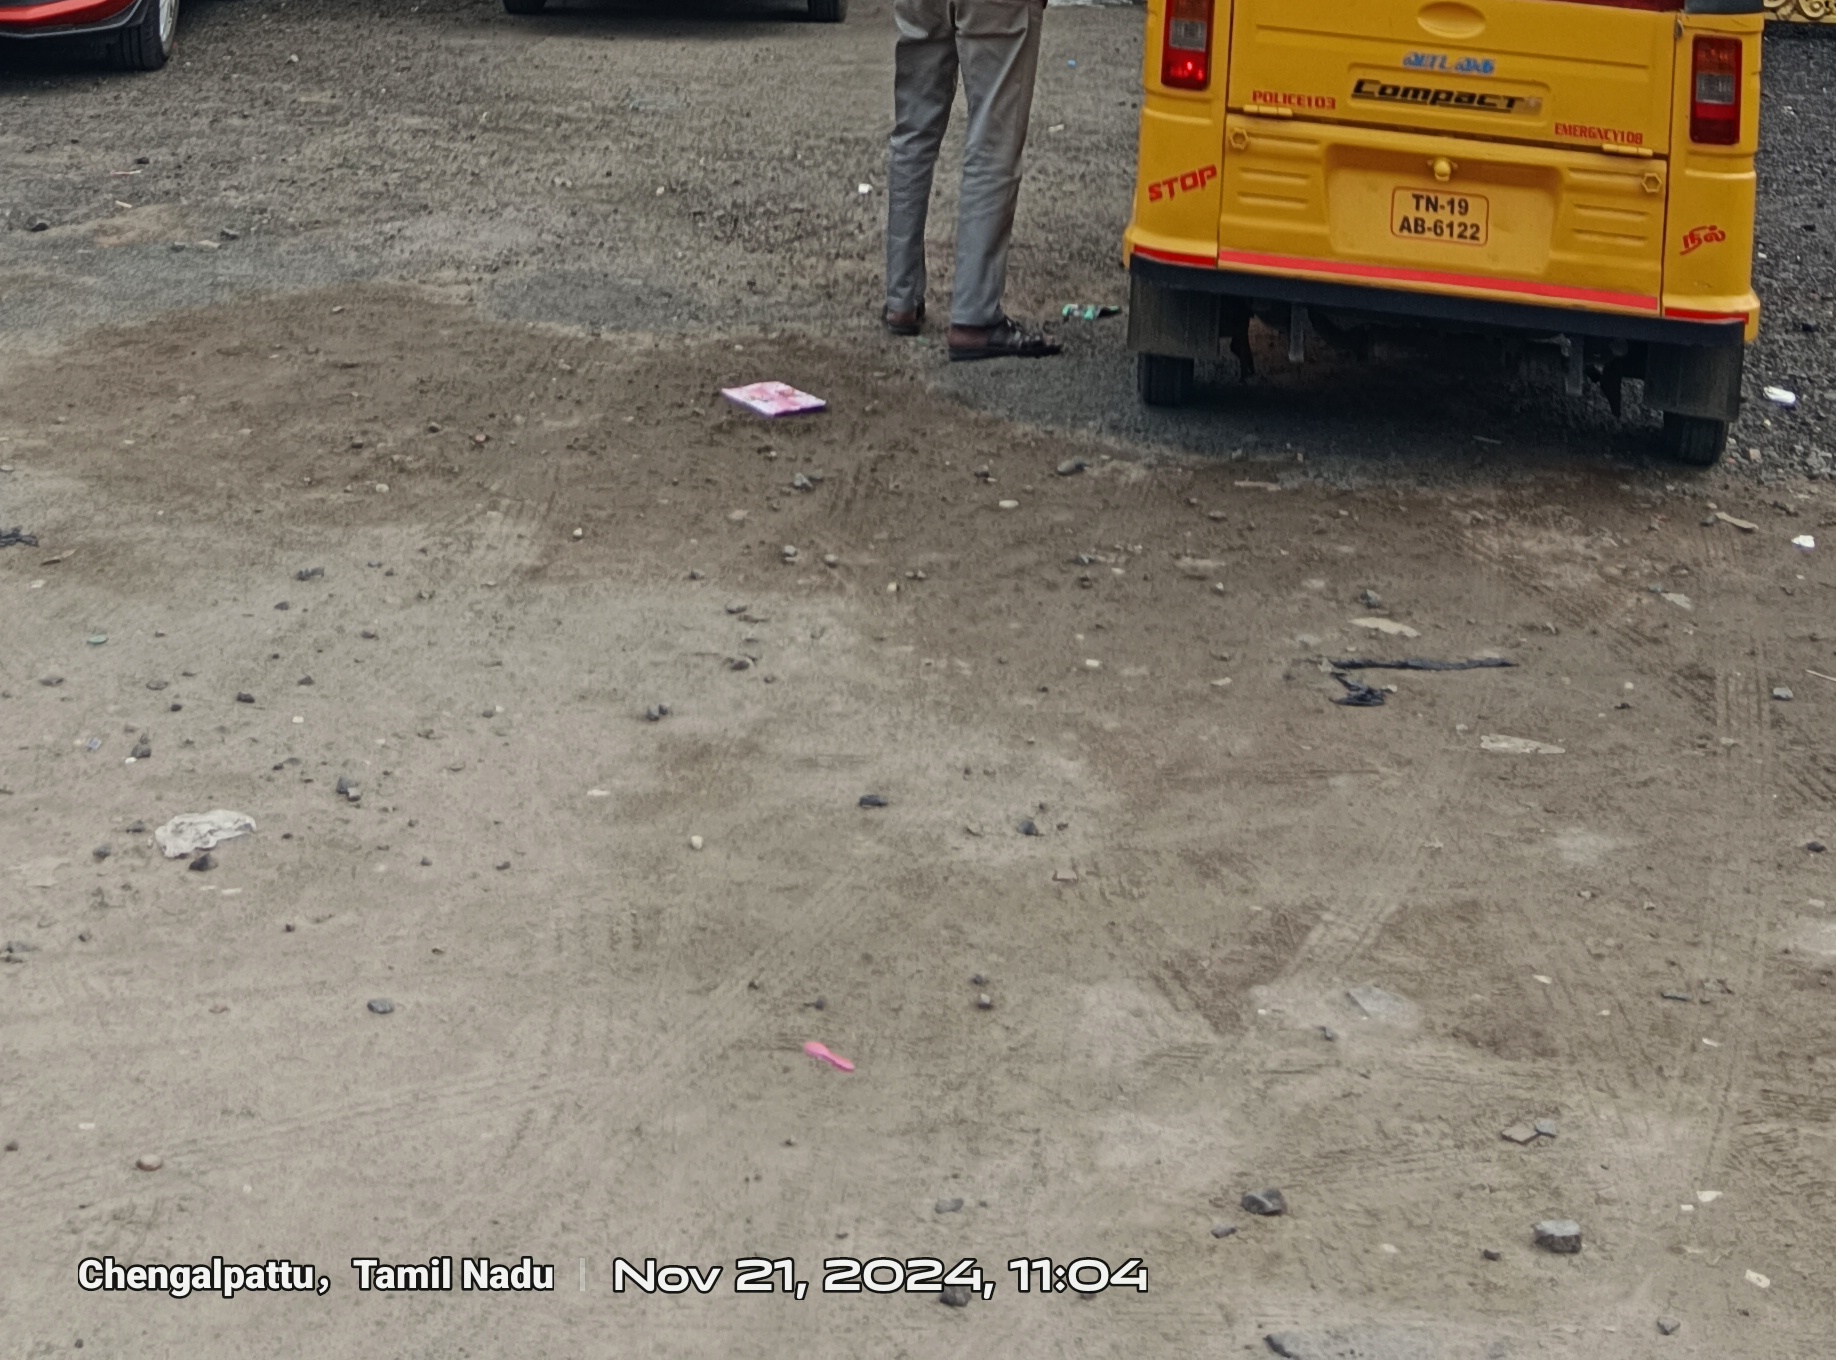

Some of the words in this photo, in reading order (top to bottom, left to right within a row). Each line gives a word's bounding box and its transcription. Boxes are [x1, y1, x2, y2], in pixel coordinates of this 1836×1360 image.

[1147, 165, 1218, 203] STOP
[1411, 193, 1469, 217] TN-19
[1399, 216, 1481, 241] AB-6122
[1680, 224, 1727, 256] நில்
